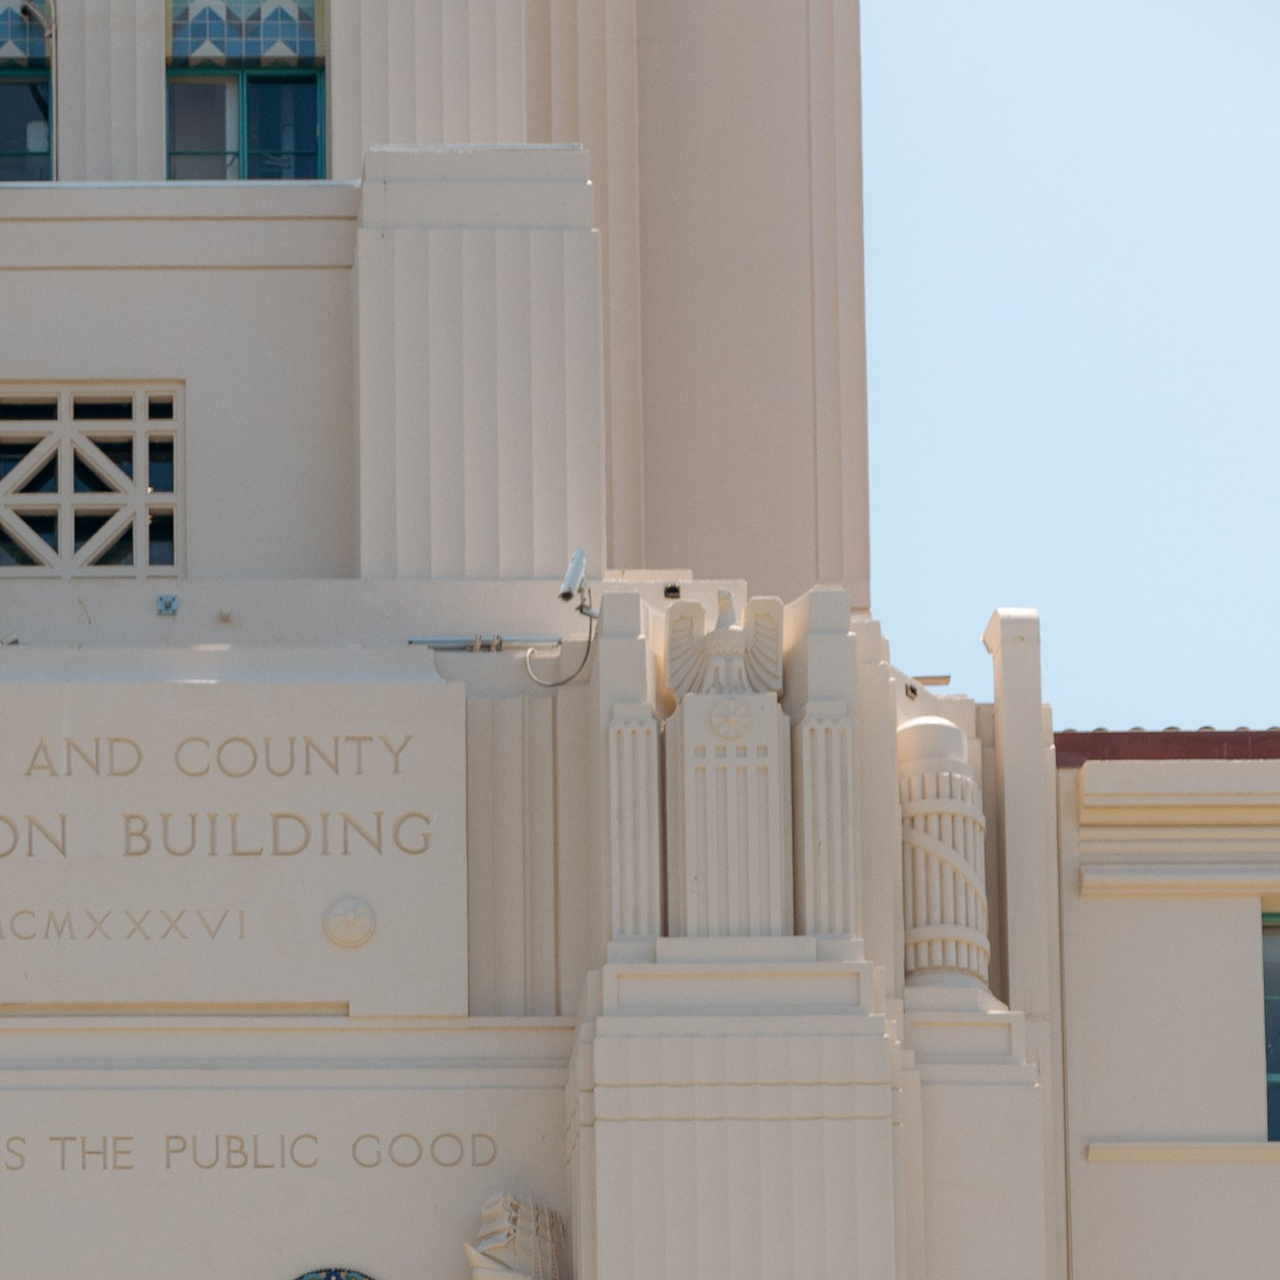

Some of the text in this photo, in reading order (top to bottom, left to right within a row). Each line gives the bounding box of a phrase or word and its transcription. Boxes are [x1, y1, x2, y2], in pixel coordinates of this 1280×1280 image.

[24, 736, 143, 778] AND
[175, 735, 414, 780] COUNTY
[122, 811, 433, 859] BUILDING
[49, 1136, 136, 1172] THE
[165, 1134, 320, 1171] PUBLIC
[352, 1133, 499, 1170] GOOD
